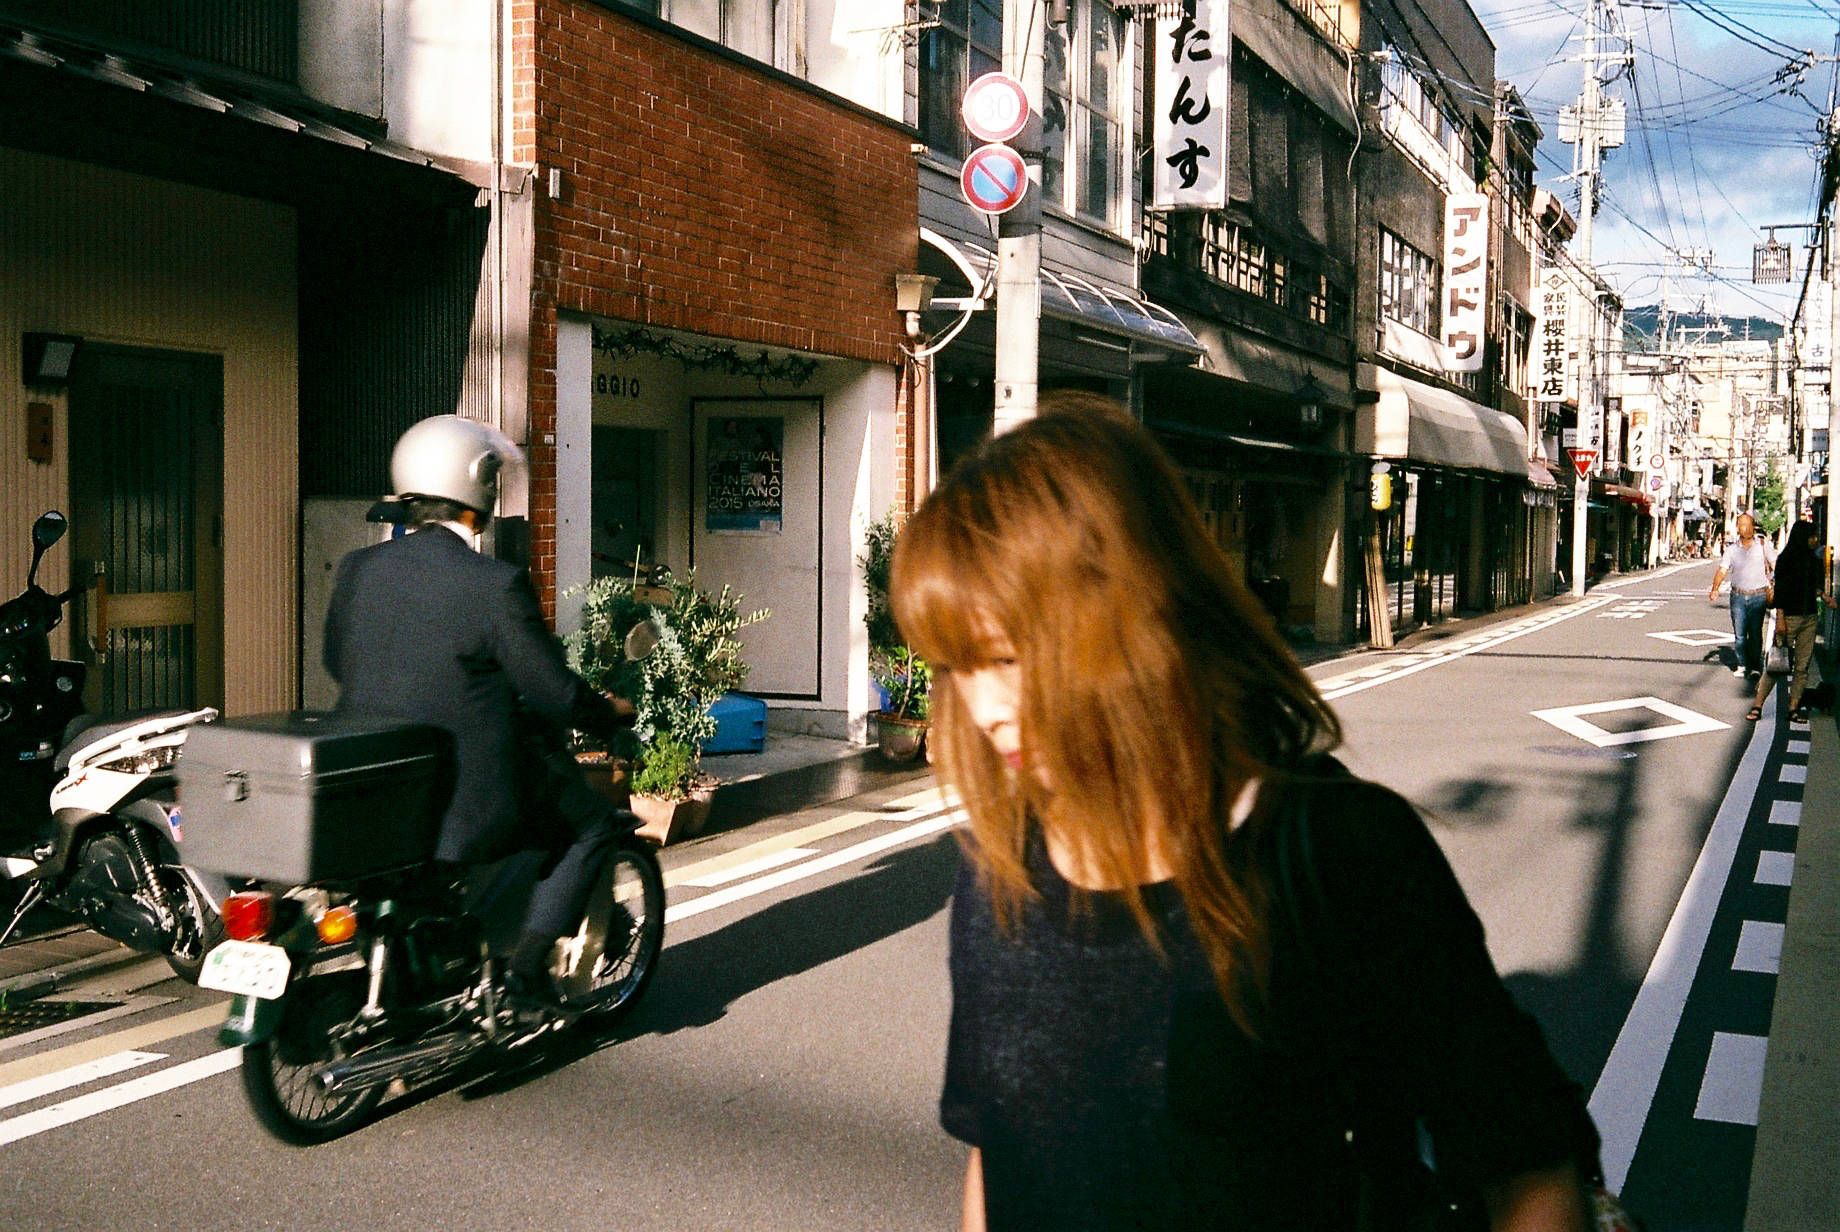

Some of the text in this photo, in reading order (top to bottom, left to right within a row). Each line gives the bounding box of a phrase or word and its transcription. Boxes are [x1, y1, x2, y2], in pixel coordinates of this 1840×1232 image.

[980, 94, 1014, 122] 30
[1166, 17, 1212, 189] たんす
[1446, 206, 1482, 360] アンドウ
[1541, 319, 1565, 396] 櫻井東店
[591, 373, 640, 398] GGIO
[709, 450, 780, 462] FESTIVAL
[708, 486, 781, 498] ITALIANO
[709, 474, 780, 486] CINEMA
[708, 497, 743, 509] 2015
